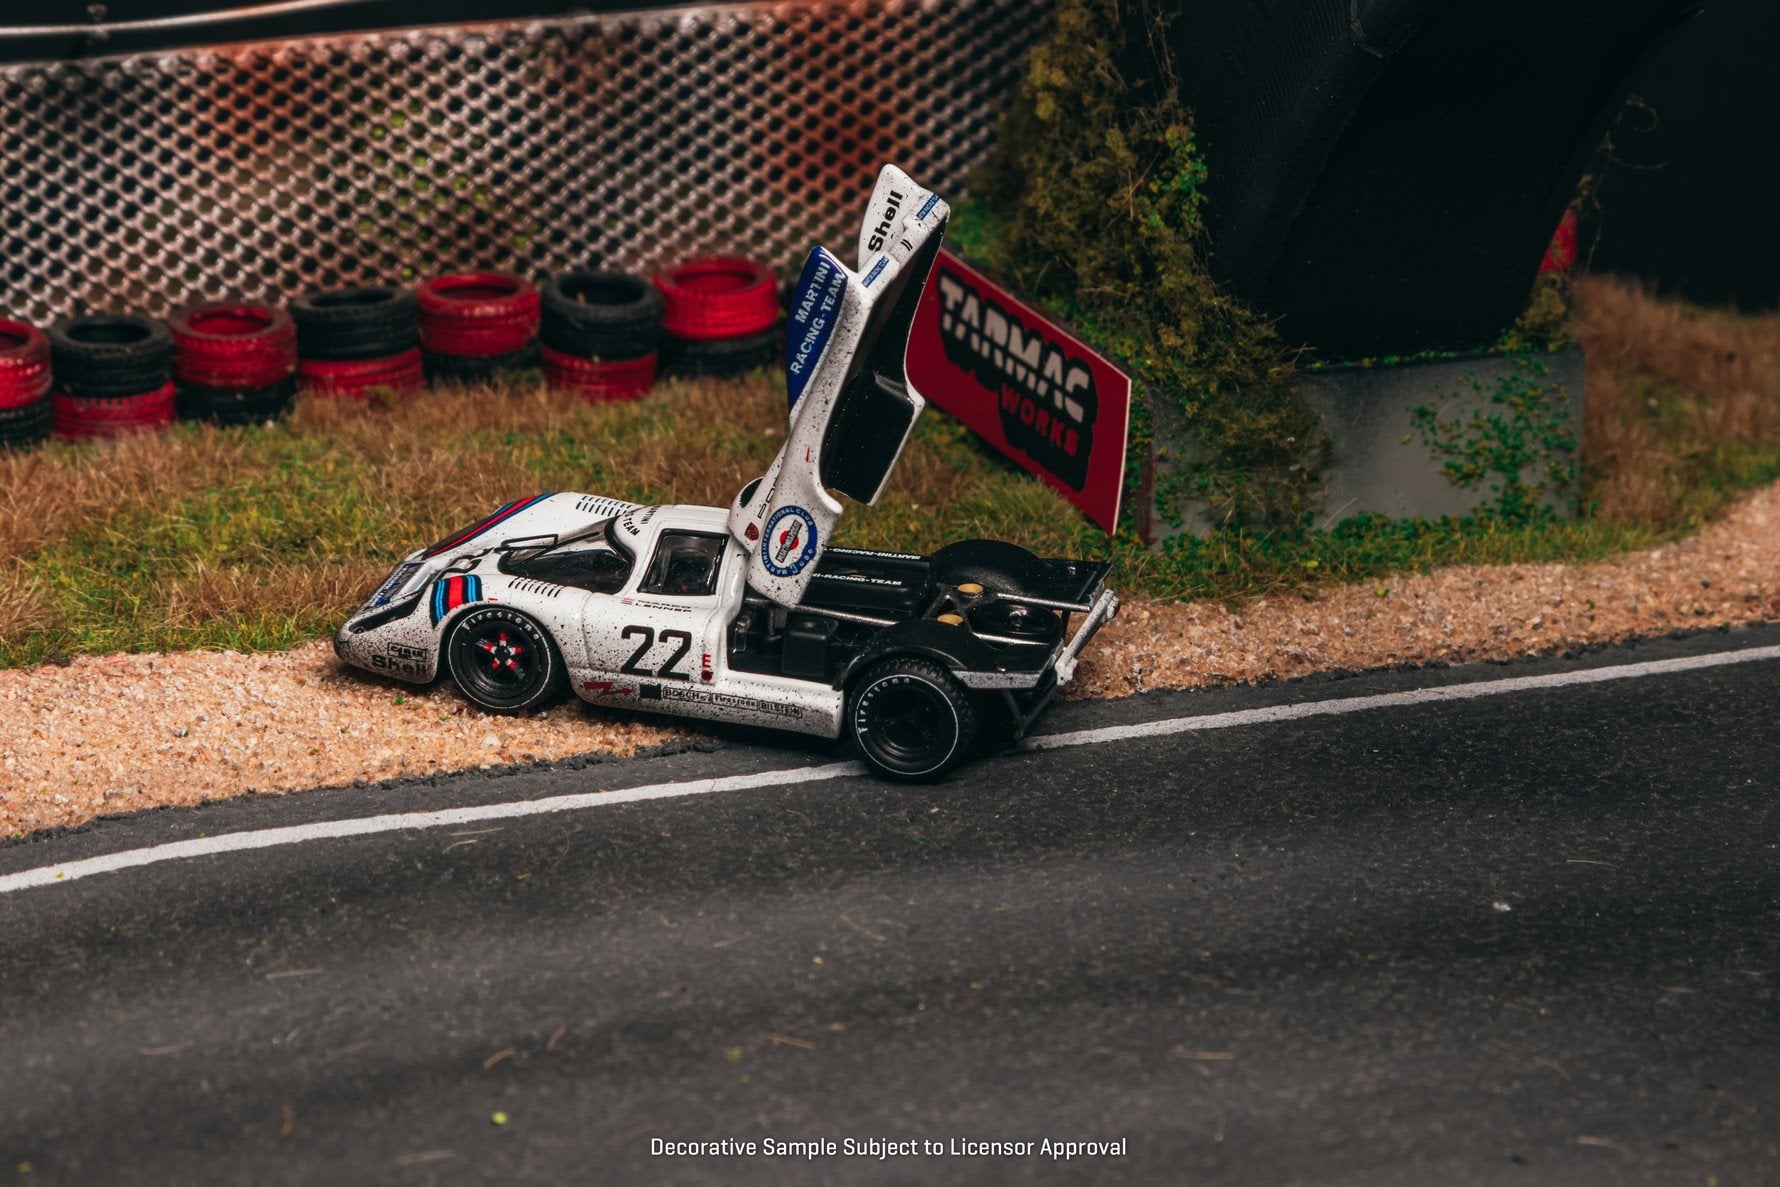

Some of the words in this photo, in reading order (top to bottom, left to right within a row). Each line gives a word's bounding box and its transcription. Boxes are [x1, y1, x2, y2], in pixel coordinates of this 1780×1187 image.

[868, 189, 903, 252] Shell
[795, 261, 831, 324] MARTINI
[939, 275, 1090, 424] TARMAC
[1001, 382, 1080, 456] WORKS
[621, 625, 692, 681] 22
[702, 653, 711, 668] E
[665, 689, 700, 700] BOSCH
